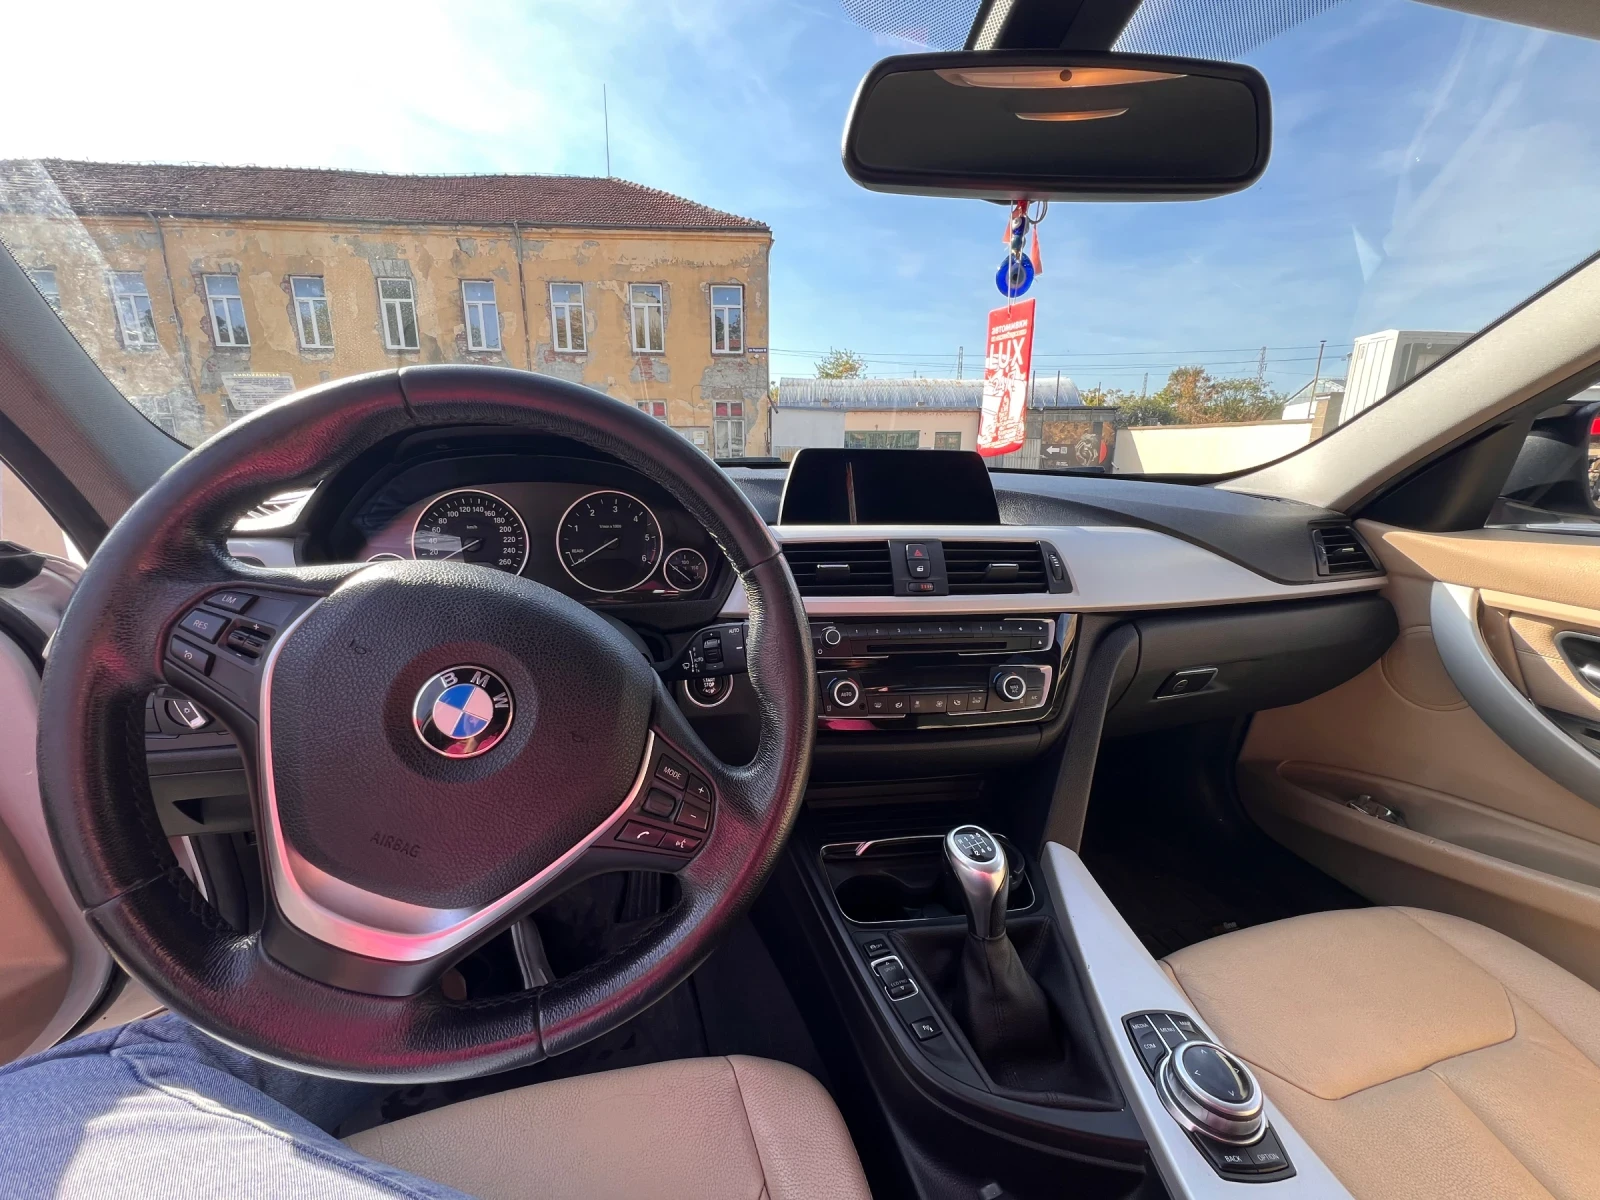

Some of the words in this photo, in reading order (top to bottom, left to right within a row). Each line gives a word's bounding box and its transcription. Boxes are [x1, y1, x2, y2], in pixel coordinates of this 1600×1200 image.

[988, 337, 1025, 369] LUX
[222, 594, 237, 604] LIM
[193, 619, 208, 630] RES
[440, 670, 509, 708] BMW
[663, 766, 682, 780] MODE
[370, 831, 421, 858] AIRBAG
[1132, 1022, 1149, 1030] MEDIA
[1257, 1153, 1280, 1161] OPTION
